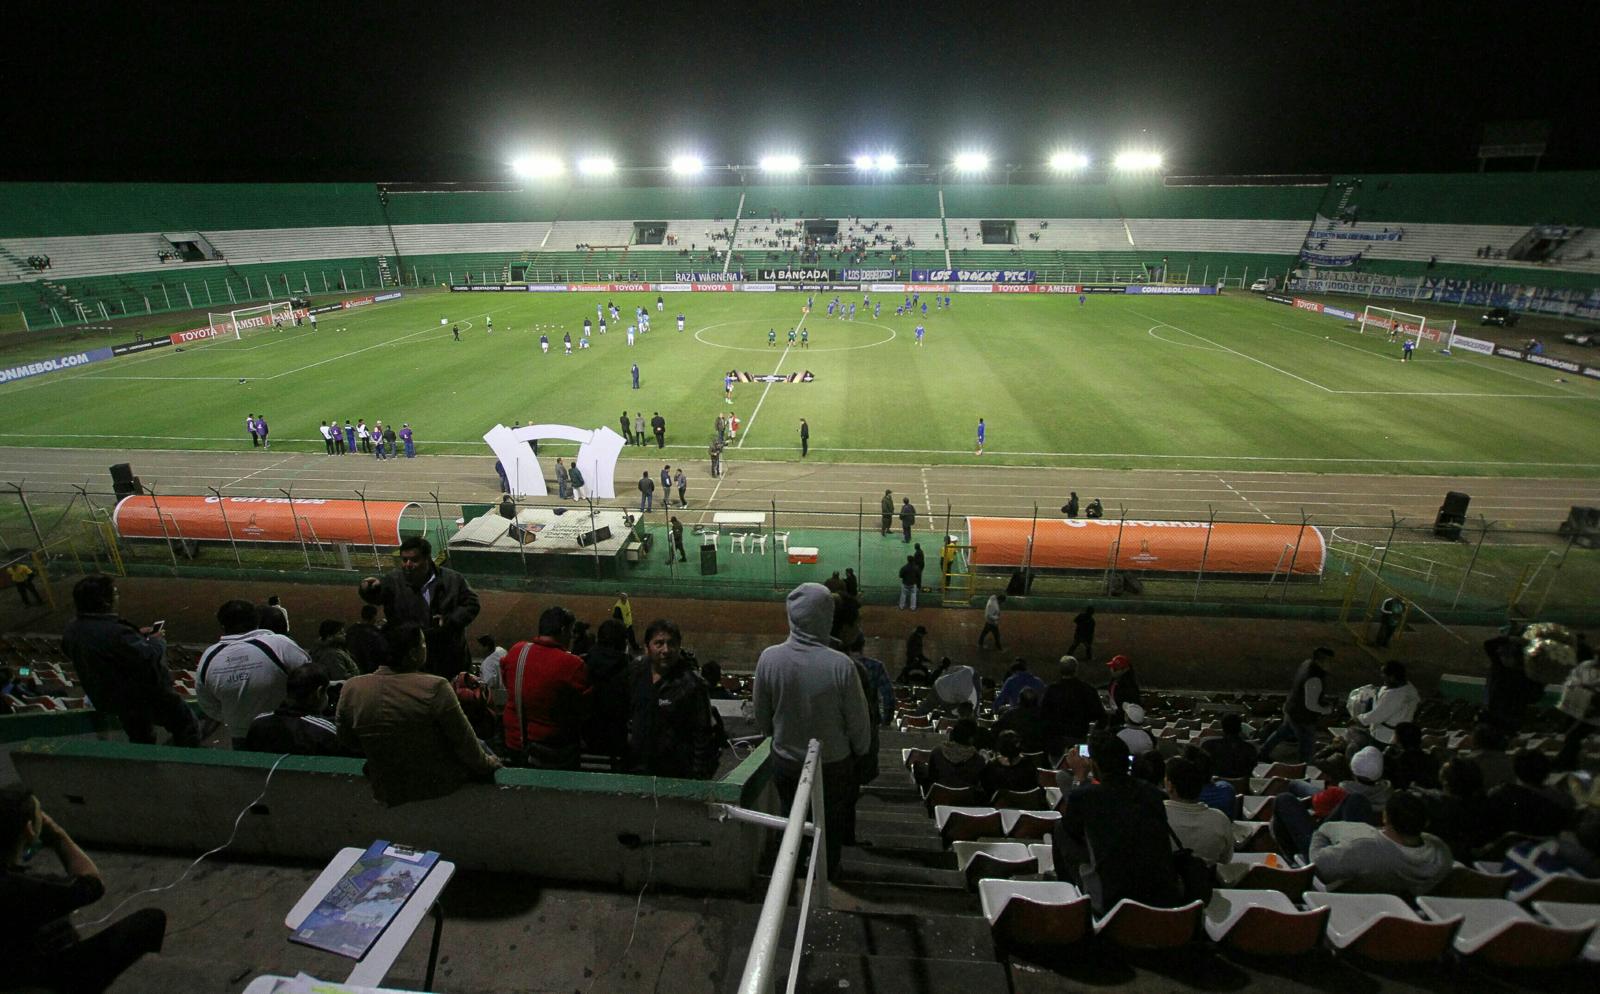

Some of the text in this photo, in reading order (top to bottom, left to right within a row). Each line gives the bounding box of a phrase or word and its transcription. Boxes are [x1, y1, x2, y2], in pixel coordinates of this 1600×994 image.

[675, 273, 696, 281] RAZA
[764, 271, 776, 279] LA
[930, 270, 952, 281] LOS
[1046, 285, 1078, 293] AMSTEL
[1296, 300, 1318, 311] TOYOTA
[236, 316, 266, 330] AMSTEL
[180, 327, 218, 342] TOYOTA
[0, 353, 89, 382] ONMEBOL.COM
